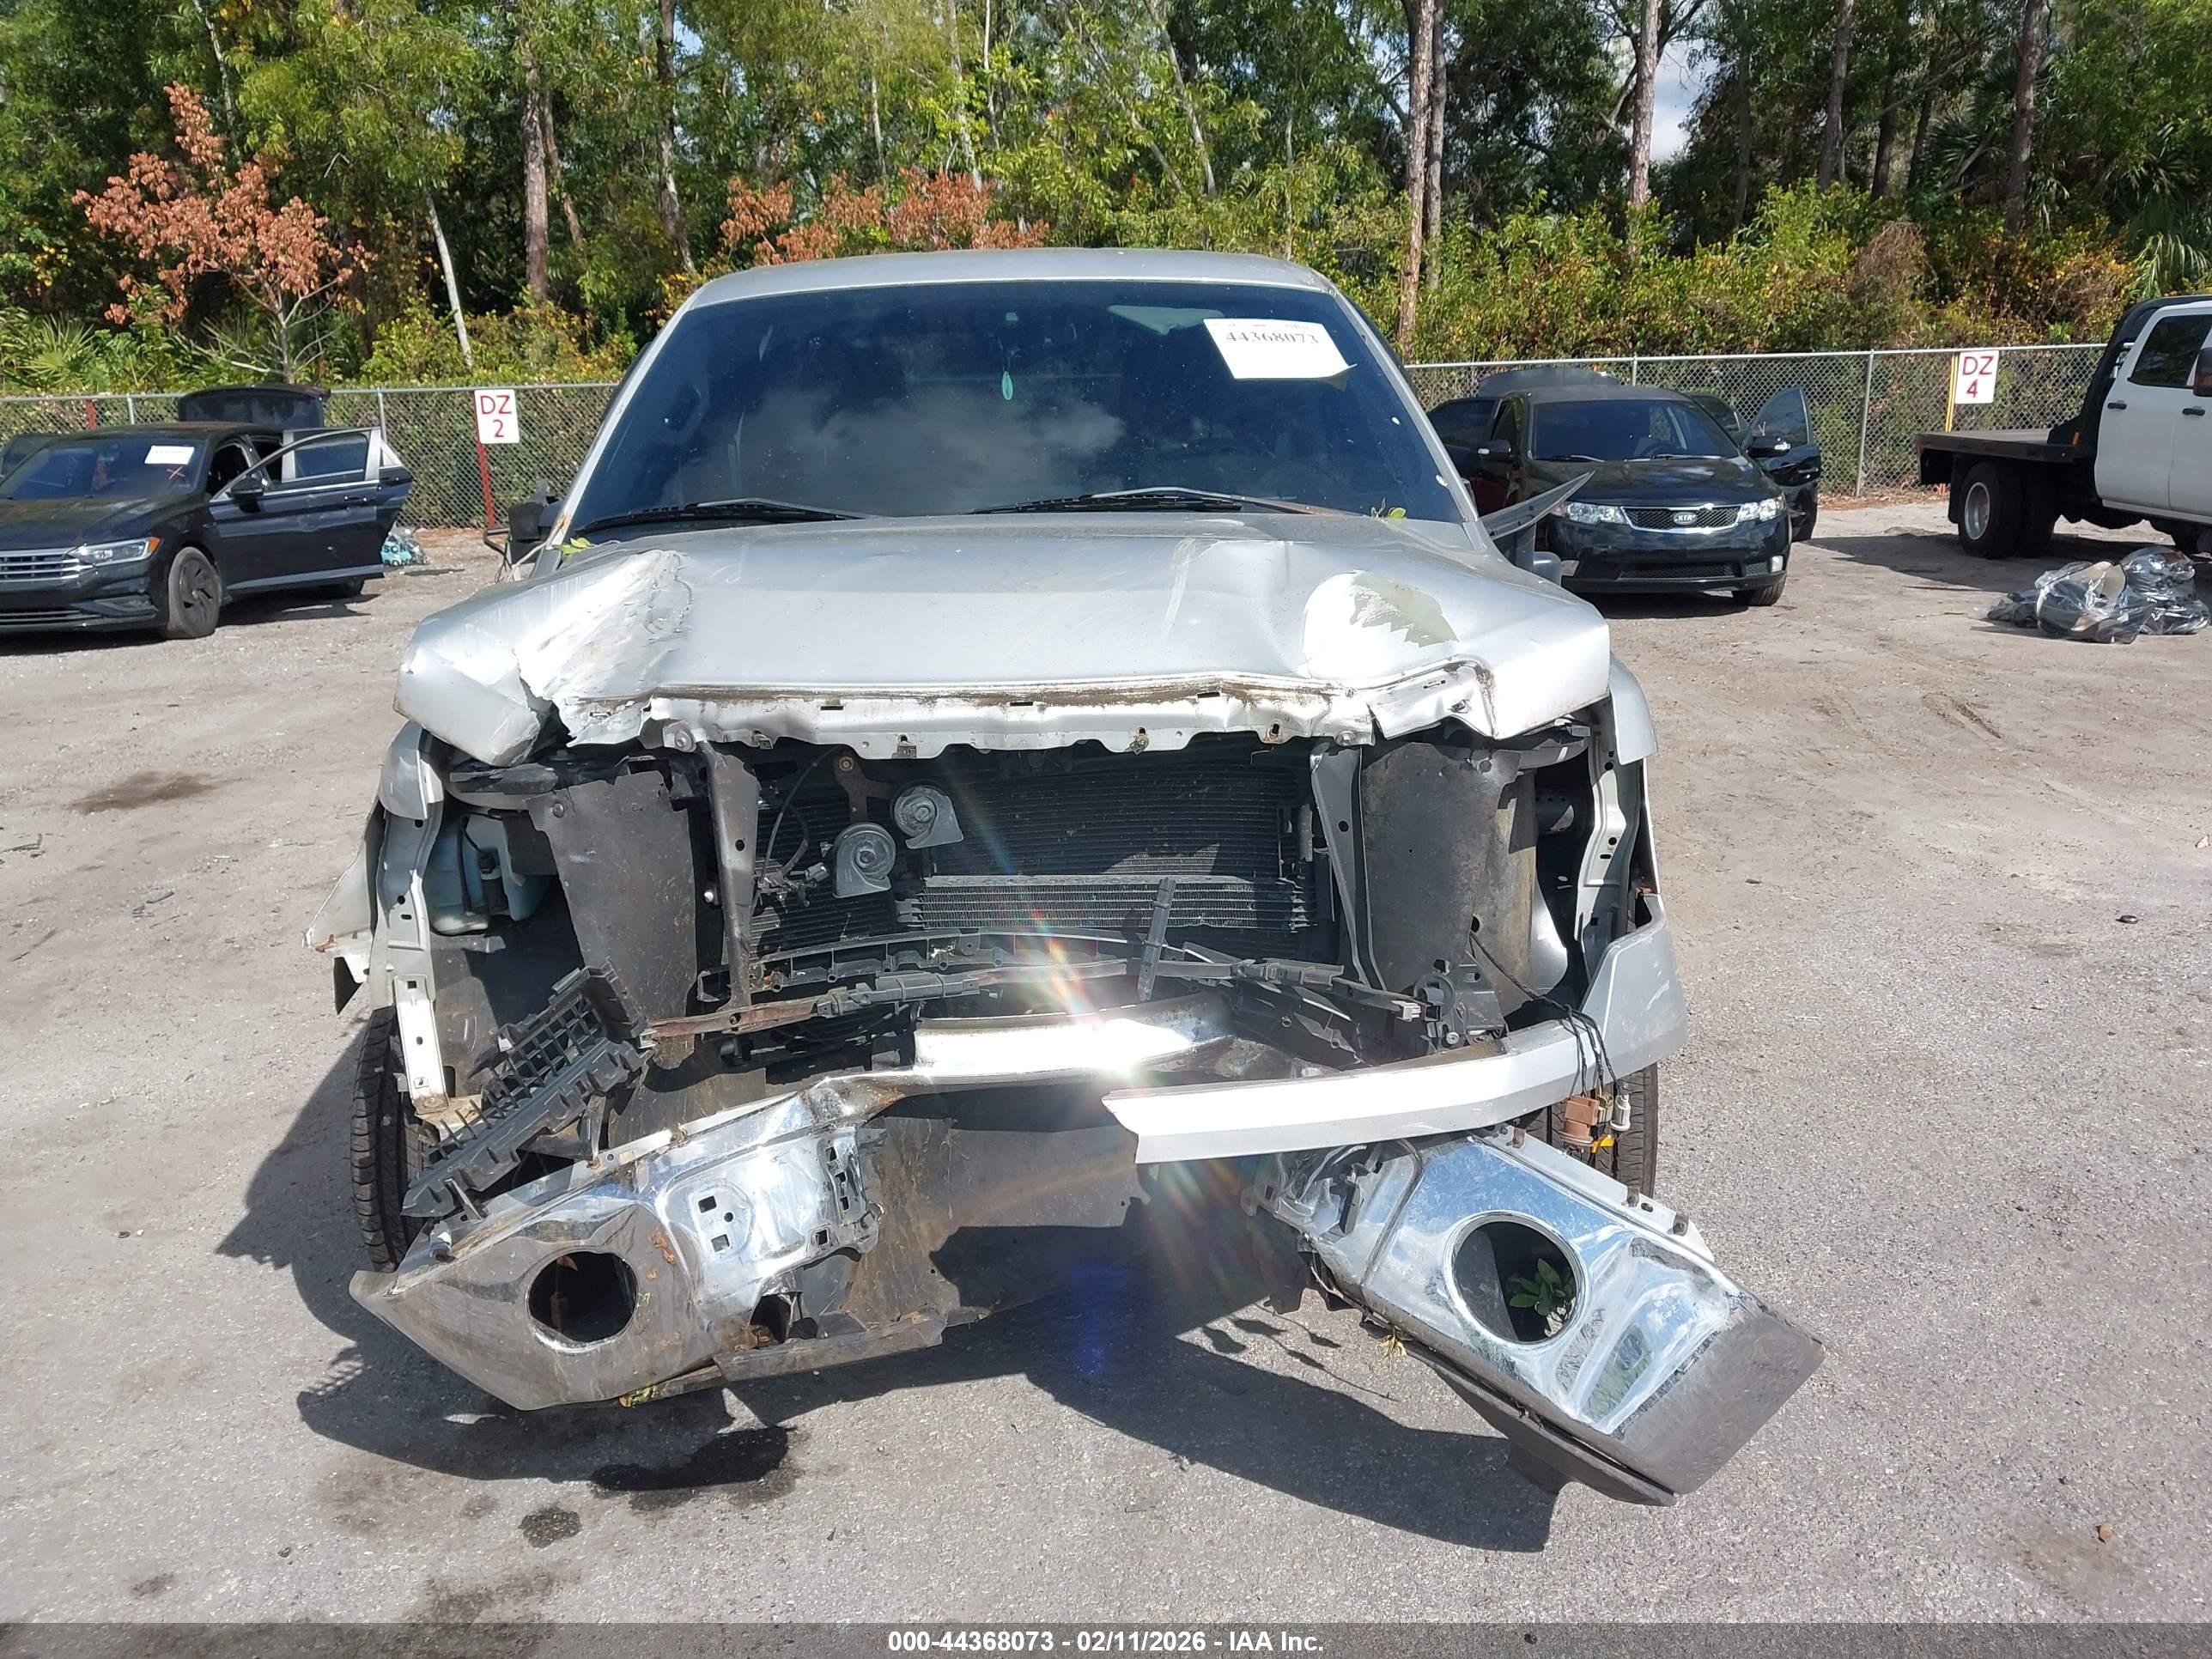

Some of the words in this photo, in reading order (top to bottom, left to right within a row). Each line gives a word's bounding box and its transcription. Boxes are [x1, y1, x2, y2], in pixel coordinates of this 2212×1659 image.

[1225, 331, 1319, 344] 44368073
[1962, 356, 1995, 376] DZ
[1966, 379, 1978, 398] 4
[480, 394, 512, 415] DZ
[492, 418, 505, 438] 2
